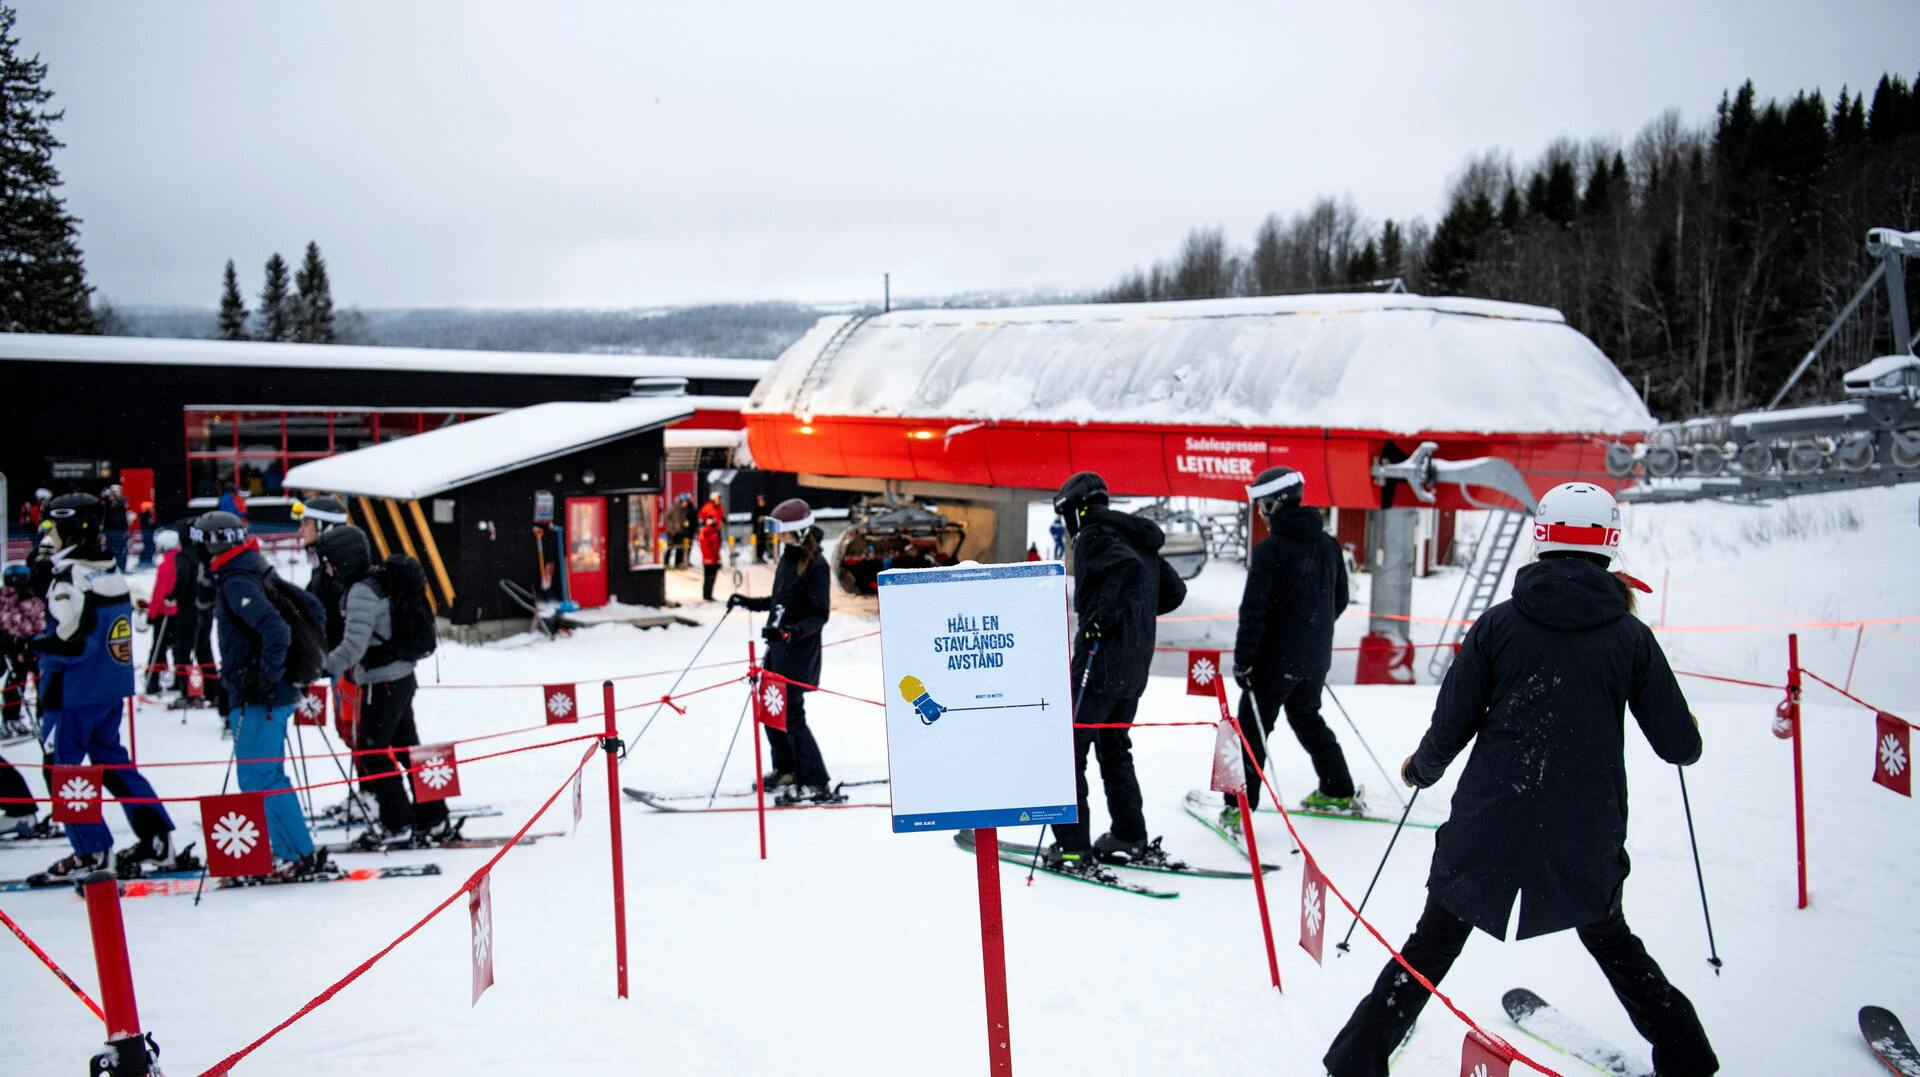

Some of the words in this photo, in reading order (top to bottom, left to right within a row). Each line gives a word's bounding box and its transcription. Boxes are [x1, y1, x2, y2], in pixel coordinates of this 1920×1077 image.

[1185, 437, 1267, 454] Sadelexpressen
[1176, 455, 1253, 475] LEITNER
[947, 613, 980, 633] HÅLL
[982, 615, 999, 631] EN
[934, 632, 1015, 653] STAVLÄNGDS
[947, 649, 1004, 670] AVSTÅND
